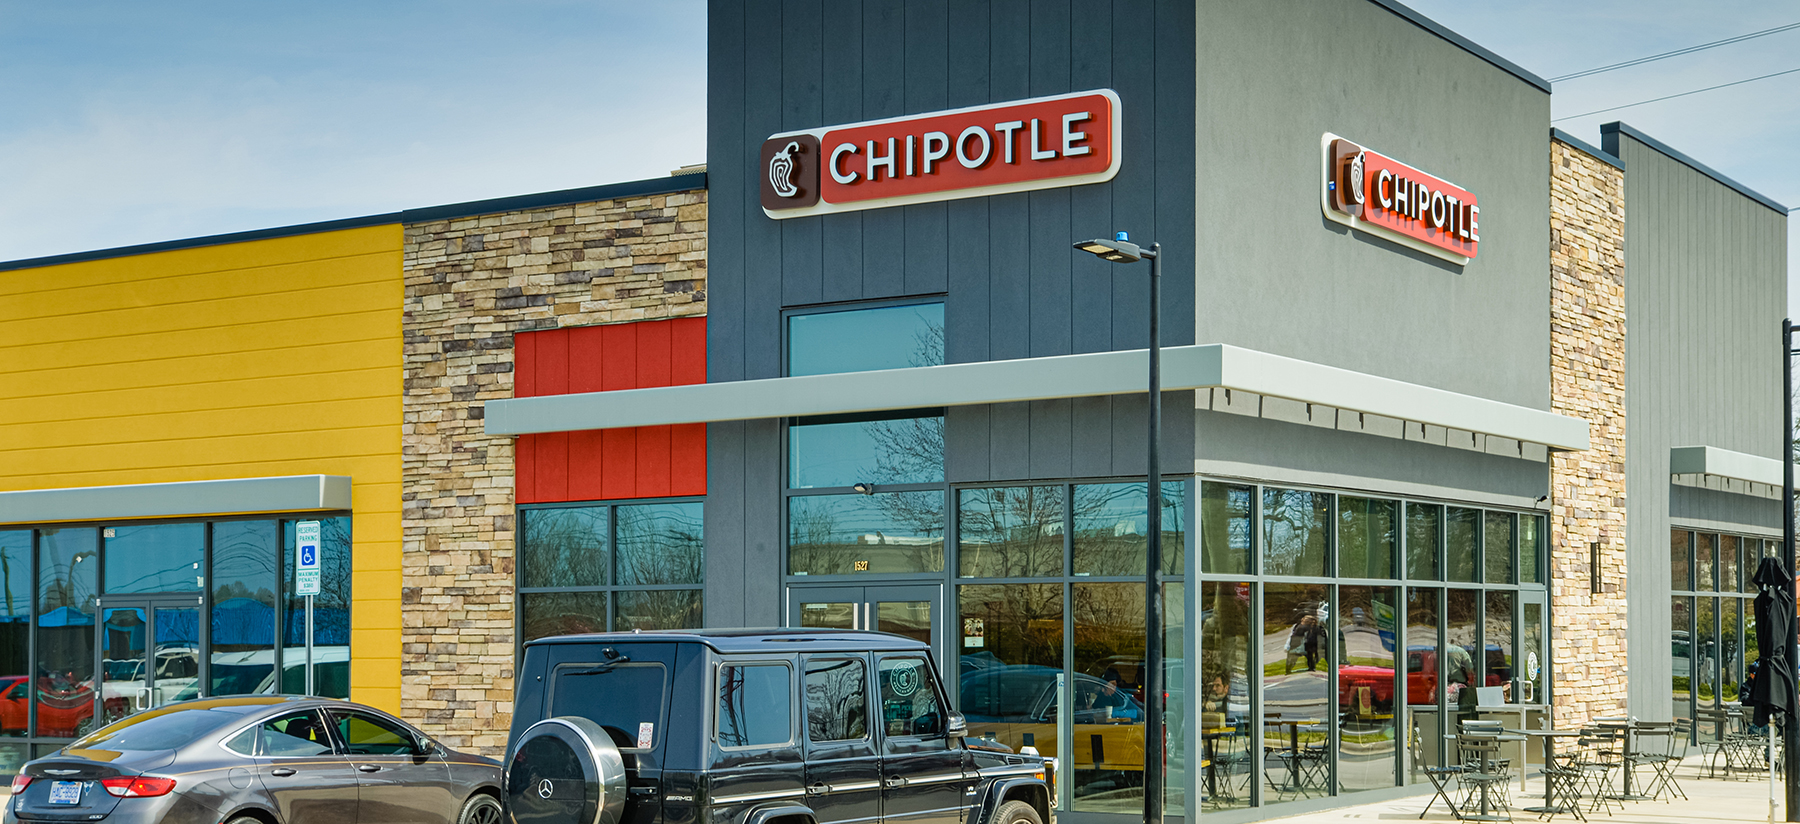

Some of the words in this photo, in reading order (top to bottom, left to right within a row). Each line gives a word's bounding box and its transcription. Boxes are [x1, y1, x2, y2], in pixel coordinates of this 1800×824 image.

[829, 111, 1092, 184] CHIPOTLE
[1377, 168, 1480, 242] CHIPOTLE
[854, 560, 868, 571] 1527
